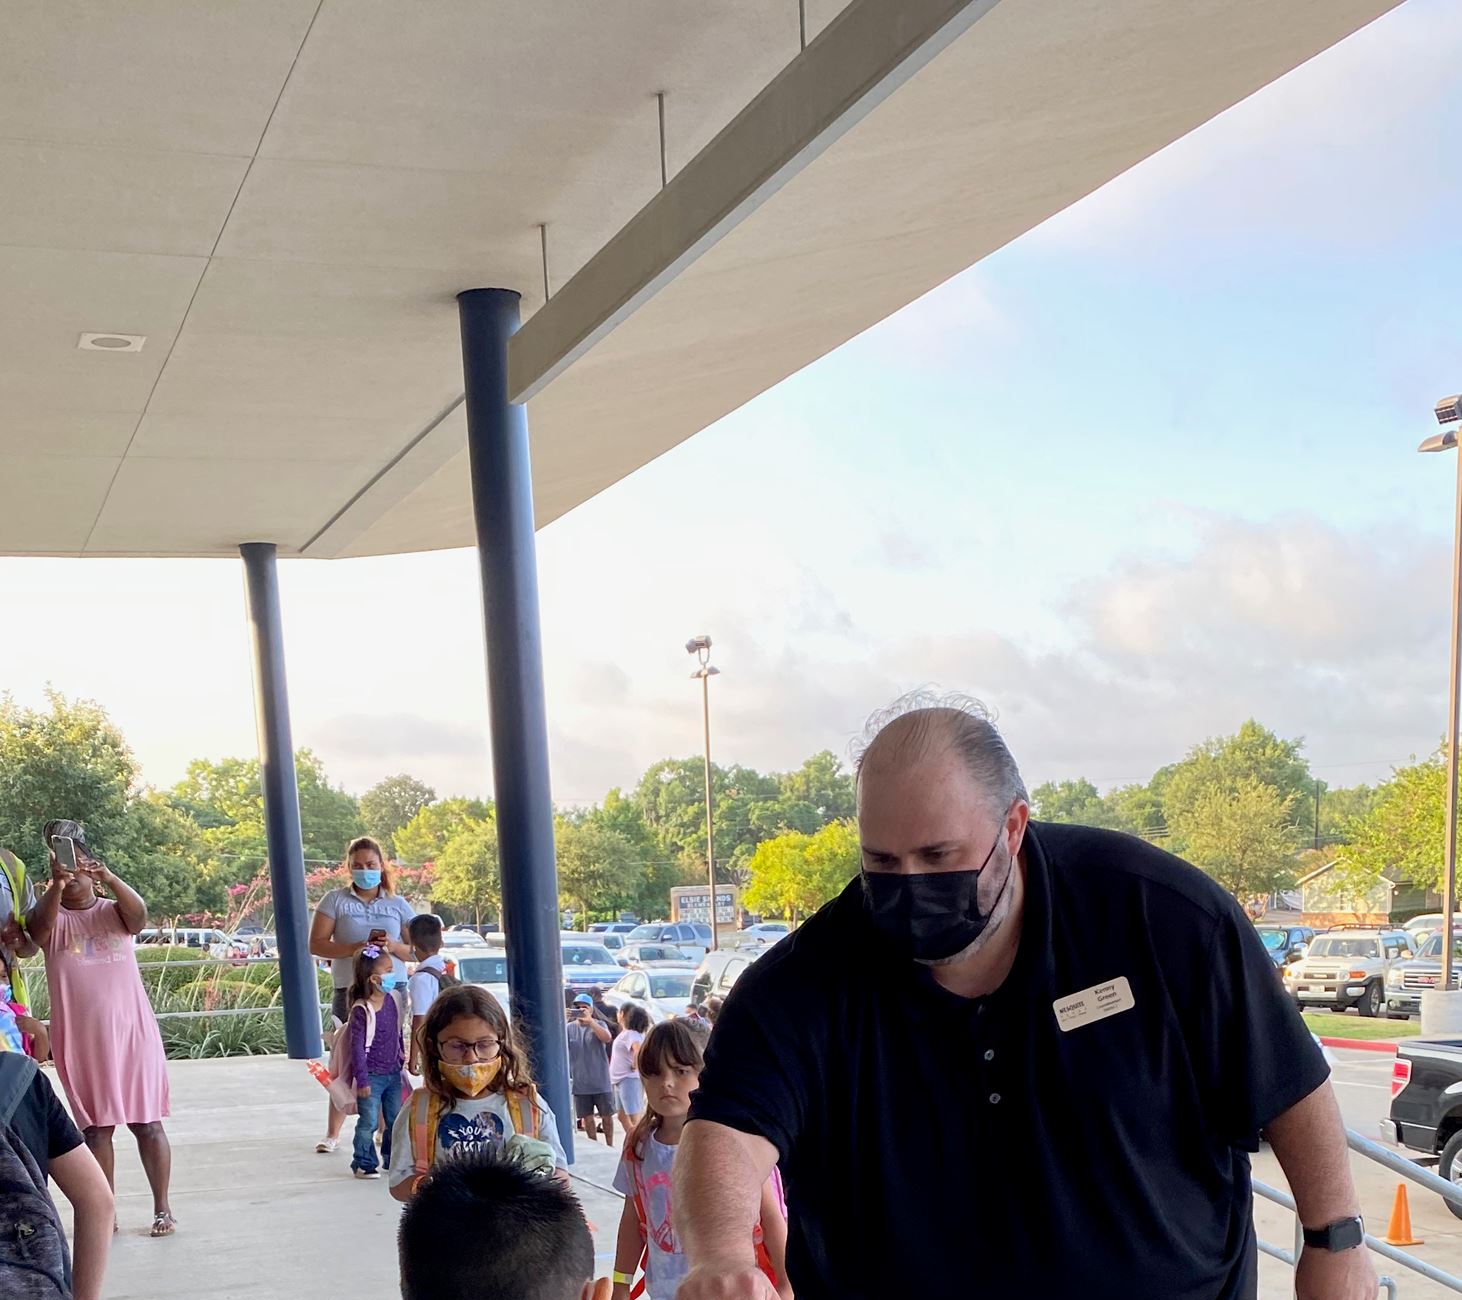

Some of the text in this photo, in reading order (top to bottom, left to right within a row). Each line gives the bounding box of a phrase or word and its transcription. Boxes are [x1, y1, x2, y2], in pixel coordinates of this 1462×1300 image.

[680, 894, 731, 904] ELSIE SNDS
[1094, 985, 1115, 995] Kenny
[1097, 992, 1117, 1002] Green
[459, 1126, 481, 1136] YOU
